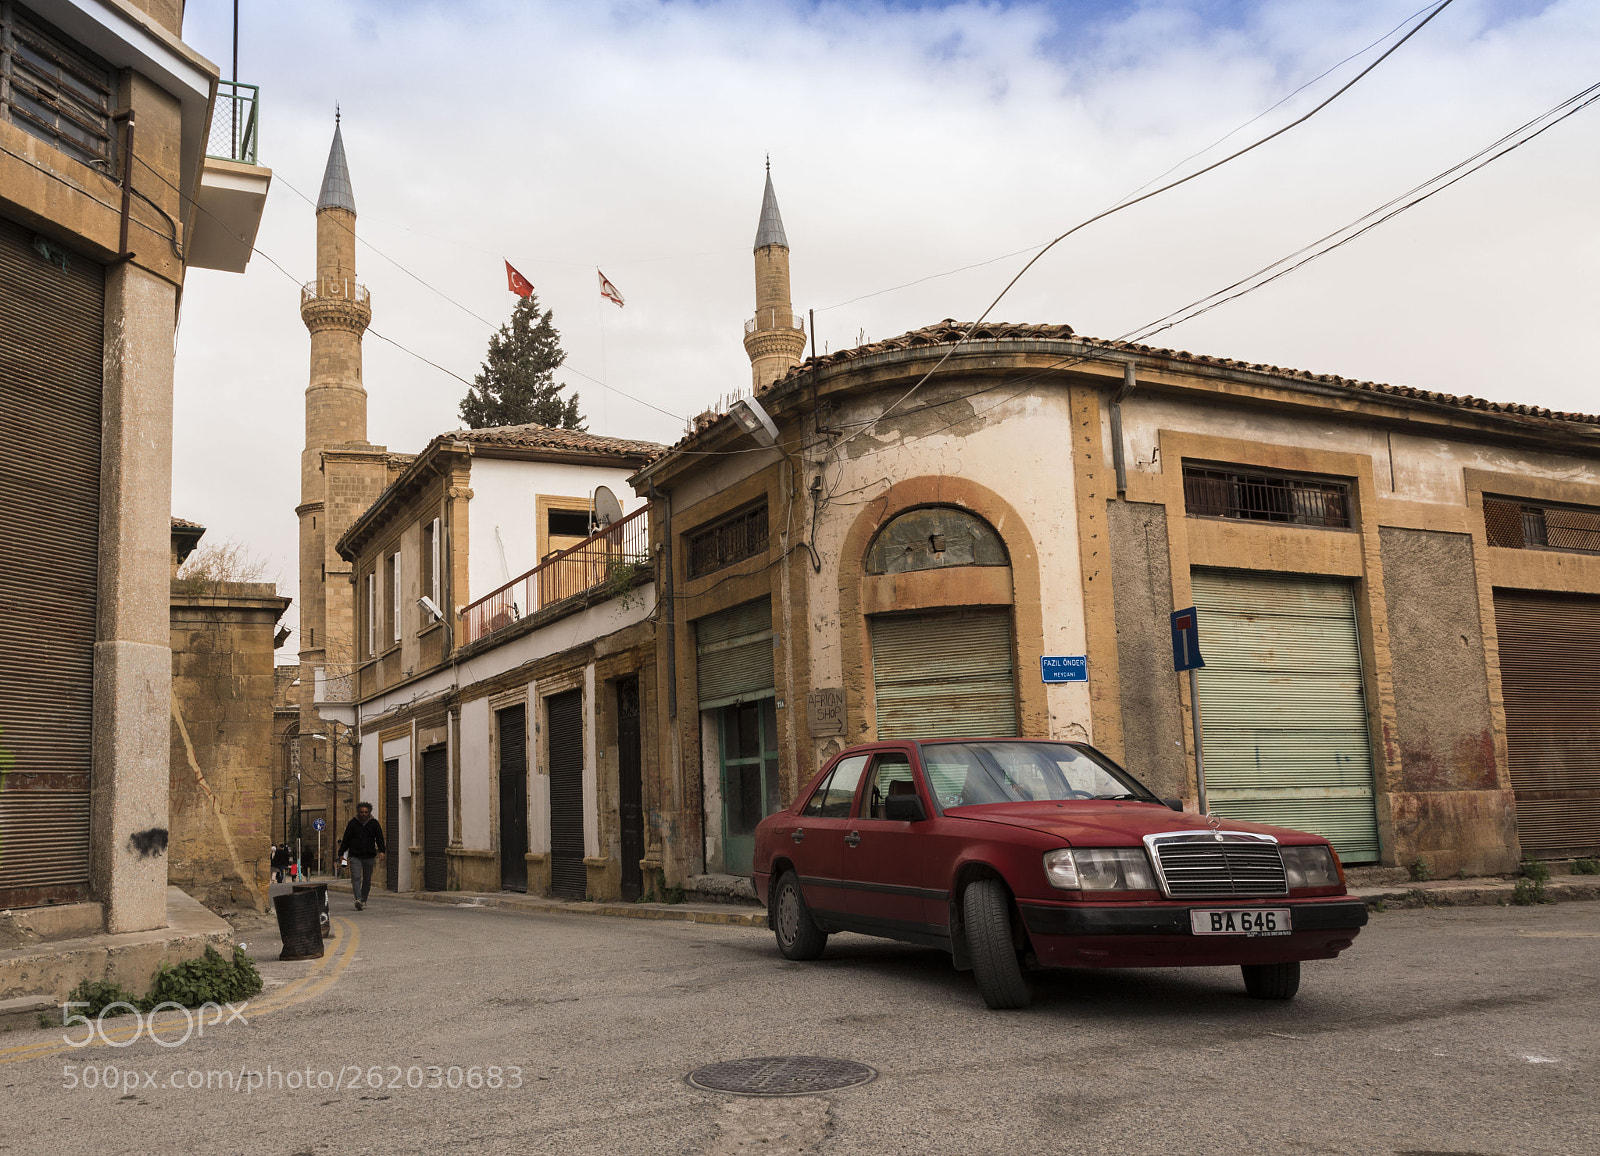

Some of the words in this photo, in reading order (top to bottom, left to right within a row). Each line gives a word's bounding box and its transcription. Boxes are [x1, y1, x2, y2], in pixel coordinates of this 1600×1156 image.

[1043, 659, 1061, 667] FAZIL
[1062, 658, 1085, 667] ÖNDER
[808, 692, 843, 709] AFRICAN
[817, 706, 842, 720] SHOP
[1209, 912, 1236, 932] BA
[1241, 911, 1276, 931] 646
